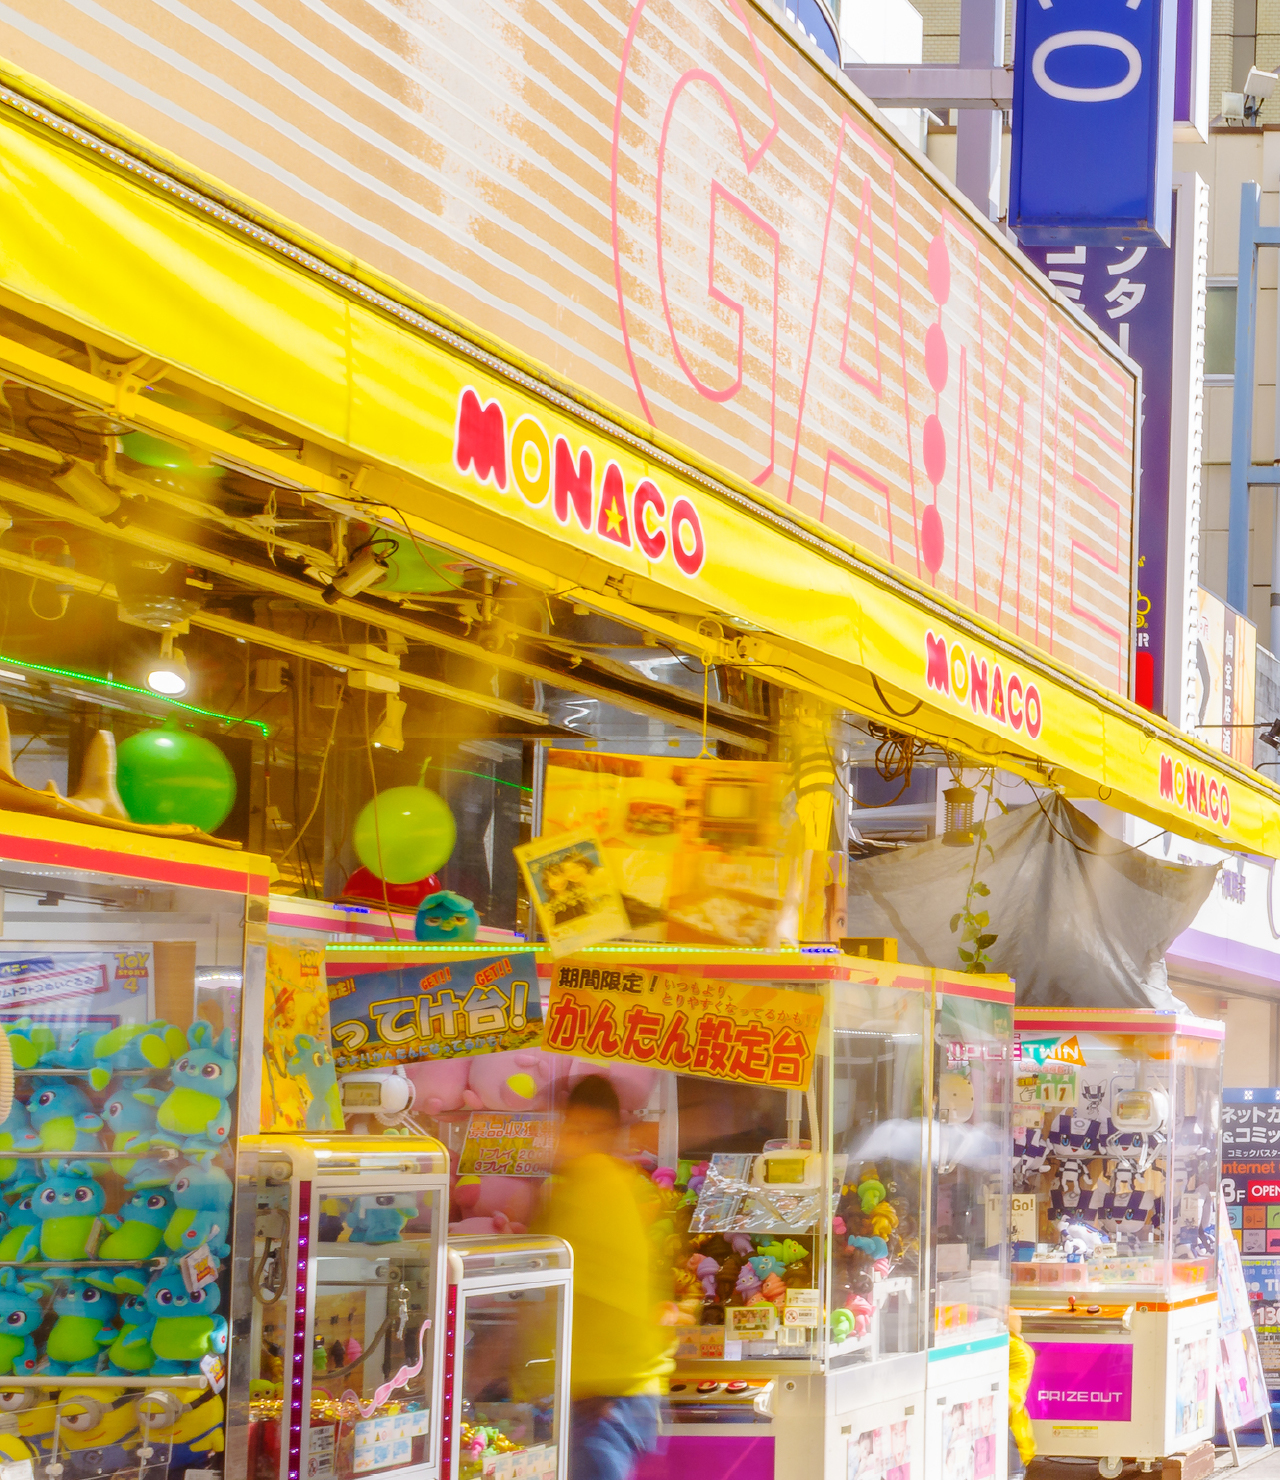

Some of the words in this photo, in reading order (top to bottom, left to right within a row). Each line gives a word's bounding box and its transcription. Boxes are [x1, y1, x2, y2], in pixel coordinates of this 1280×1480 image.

[453, 385, 705, 575] MONACO
[924, 628, 1042, 740] MONACO
[1160, 753, 1231, 827] MONACO
[115, 952, 149, 969] TOY
[475, 958, 512, 987] GET!!
[115, 968, 149, 979] STORY
[123, 977, 139, 993] 4
[420, 967, 451, 991] GET!!
[558, 967, 659, 993] 期間限定!
[549, 994, 811, 1086] かんたん設定台
[1024, 1044, 1079, 1060] TWIN
[1222, 1178, 1245, 1202] 3F
[1012, 1198, 1034, 1211] Go!
[1038, 1390, 1088, 1401] PRIZE
[1091, 1392, 1122, 1402] OUT
